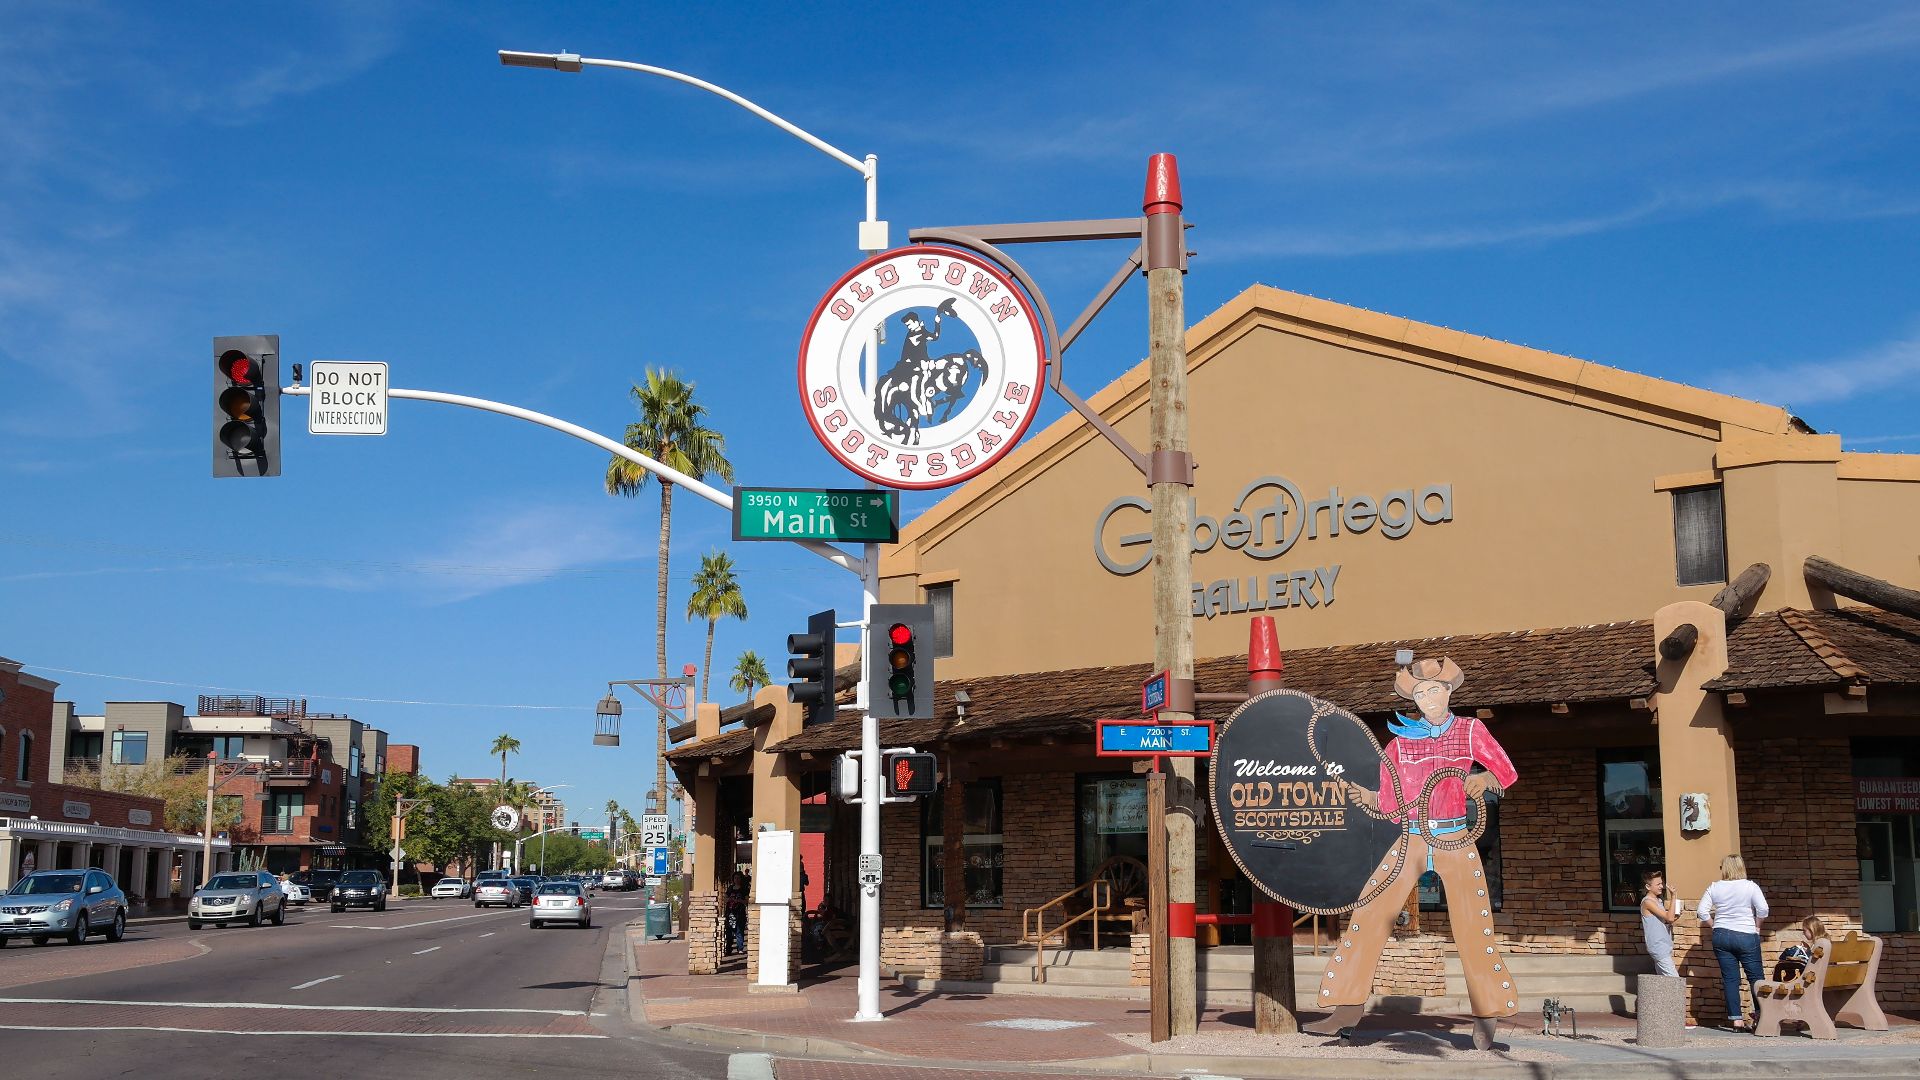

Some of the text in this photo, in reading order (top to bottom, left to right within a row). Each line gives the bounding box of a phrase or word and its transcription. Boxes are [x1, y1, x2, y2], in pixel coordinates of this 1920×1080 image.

[831, 258, 1019, 322] OLD TOWN
[316, 372, 381, 386] DO NOT
[321, 391, 376, 405] BLOCK
[314, 411, 382, 425] INTERSECTION
[813, 382, 1030, 477] SCOTTSDALE
[748, 495, 863, 508] 3950 N 7200 E
[763, 509, 868, 535] Main St
[1140, 737, 1173, 748] MAIN
[1233, 758, 1345, 777] Welcome to
[1230, 781, 1348, 808] OLD TOWN
[1857, 797, 1891, 810] LOWEST
[1234, 810, 1345, 828] SCOTTSDALE
[644, 832, 666, 844] 25
